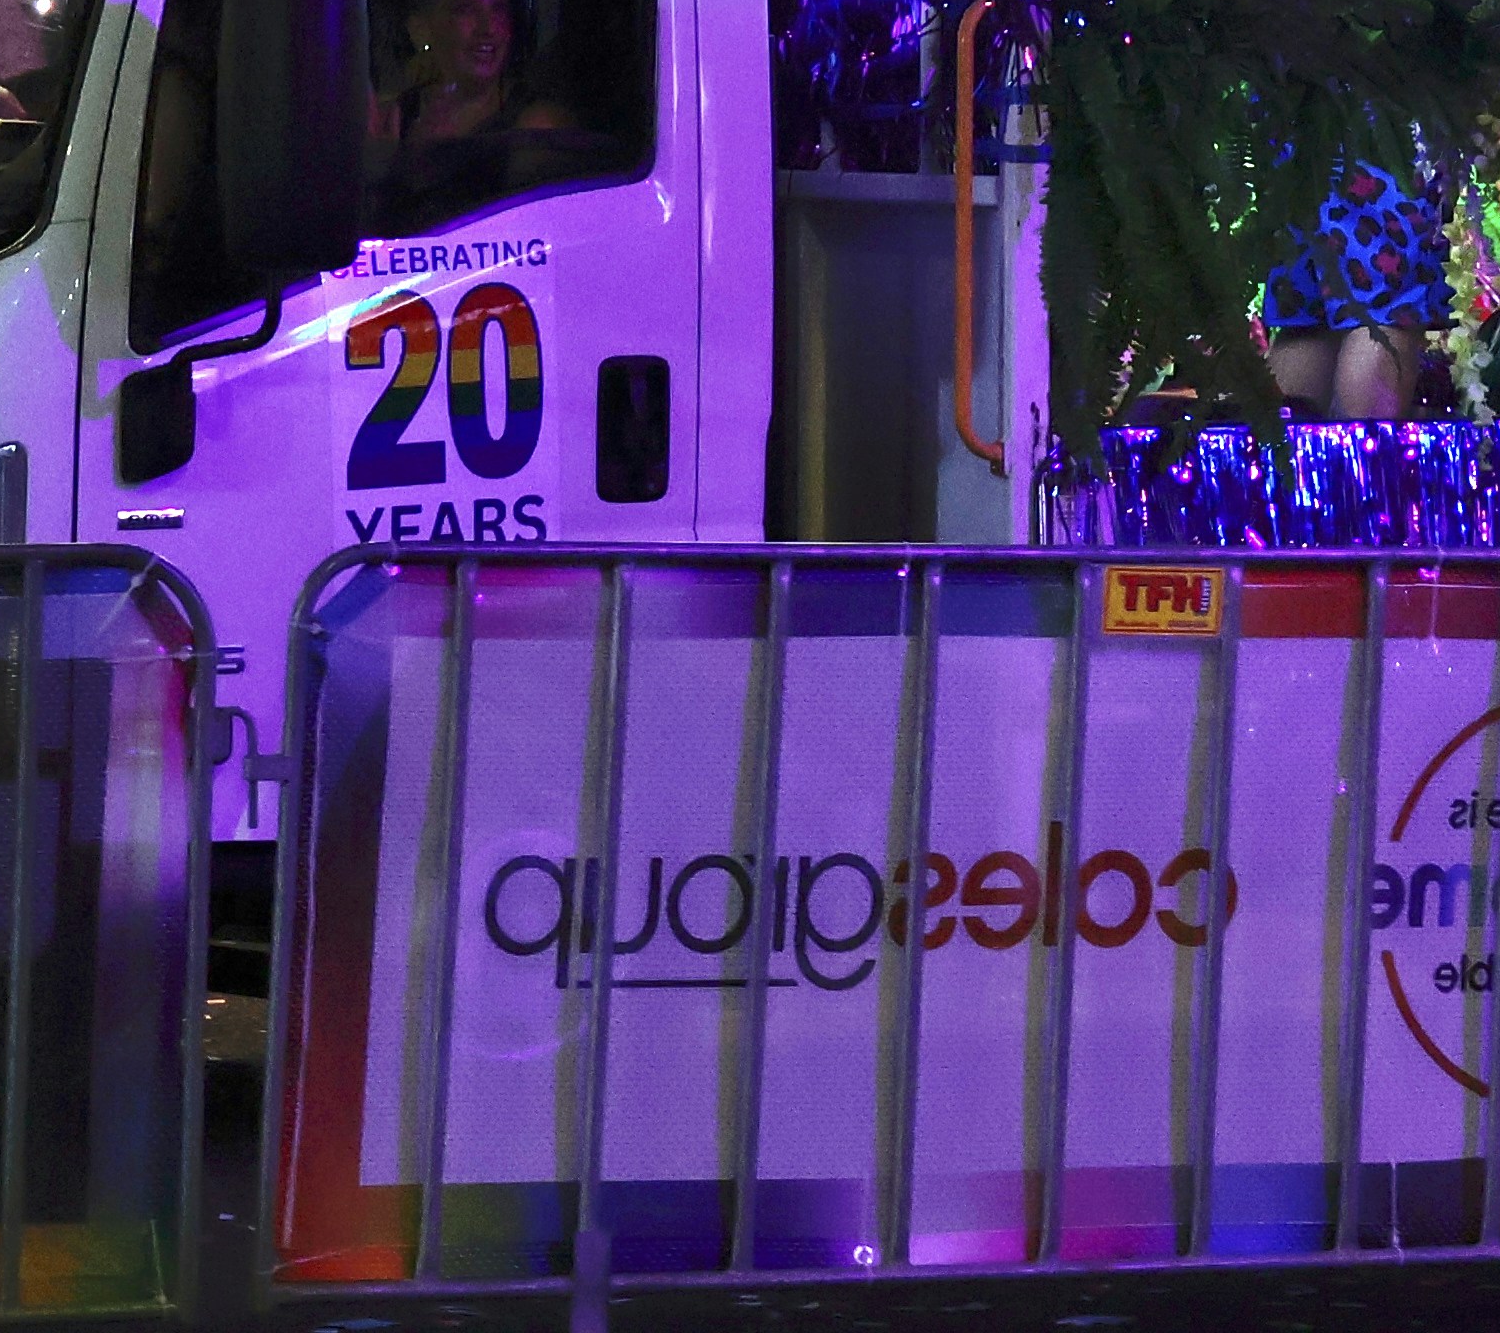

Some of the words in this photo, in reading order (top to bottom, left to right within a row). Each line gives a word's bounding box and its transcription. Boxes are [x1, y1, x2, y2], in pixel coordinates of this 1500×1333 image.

[345, 282, 543, 491] 20
[345, 494, 548, 542] YEARS
[1117, 573, 1204, 614] TFH
